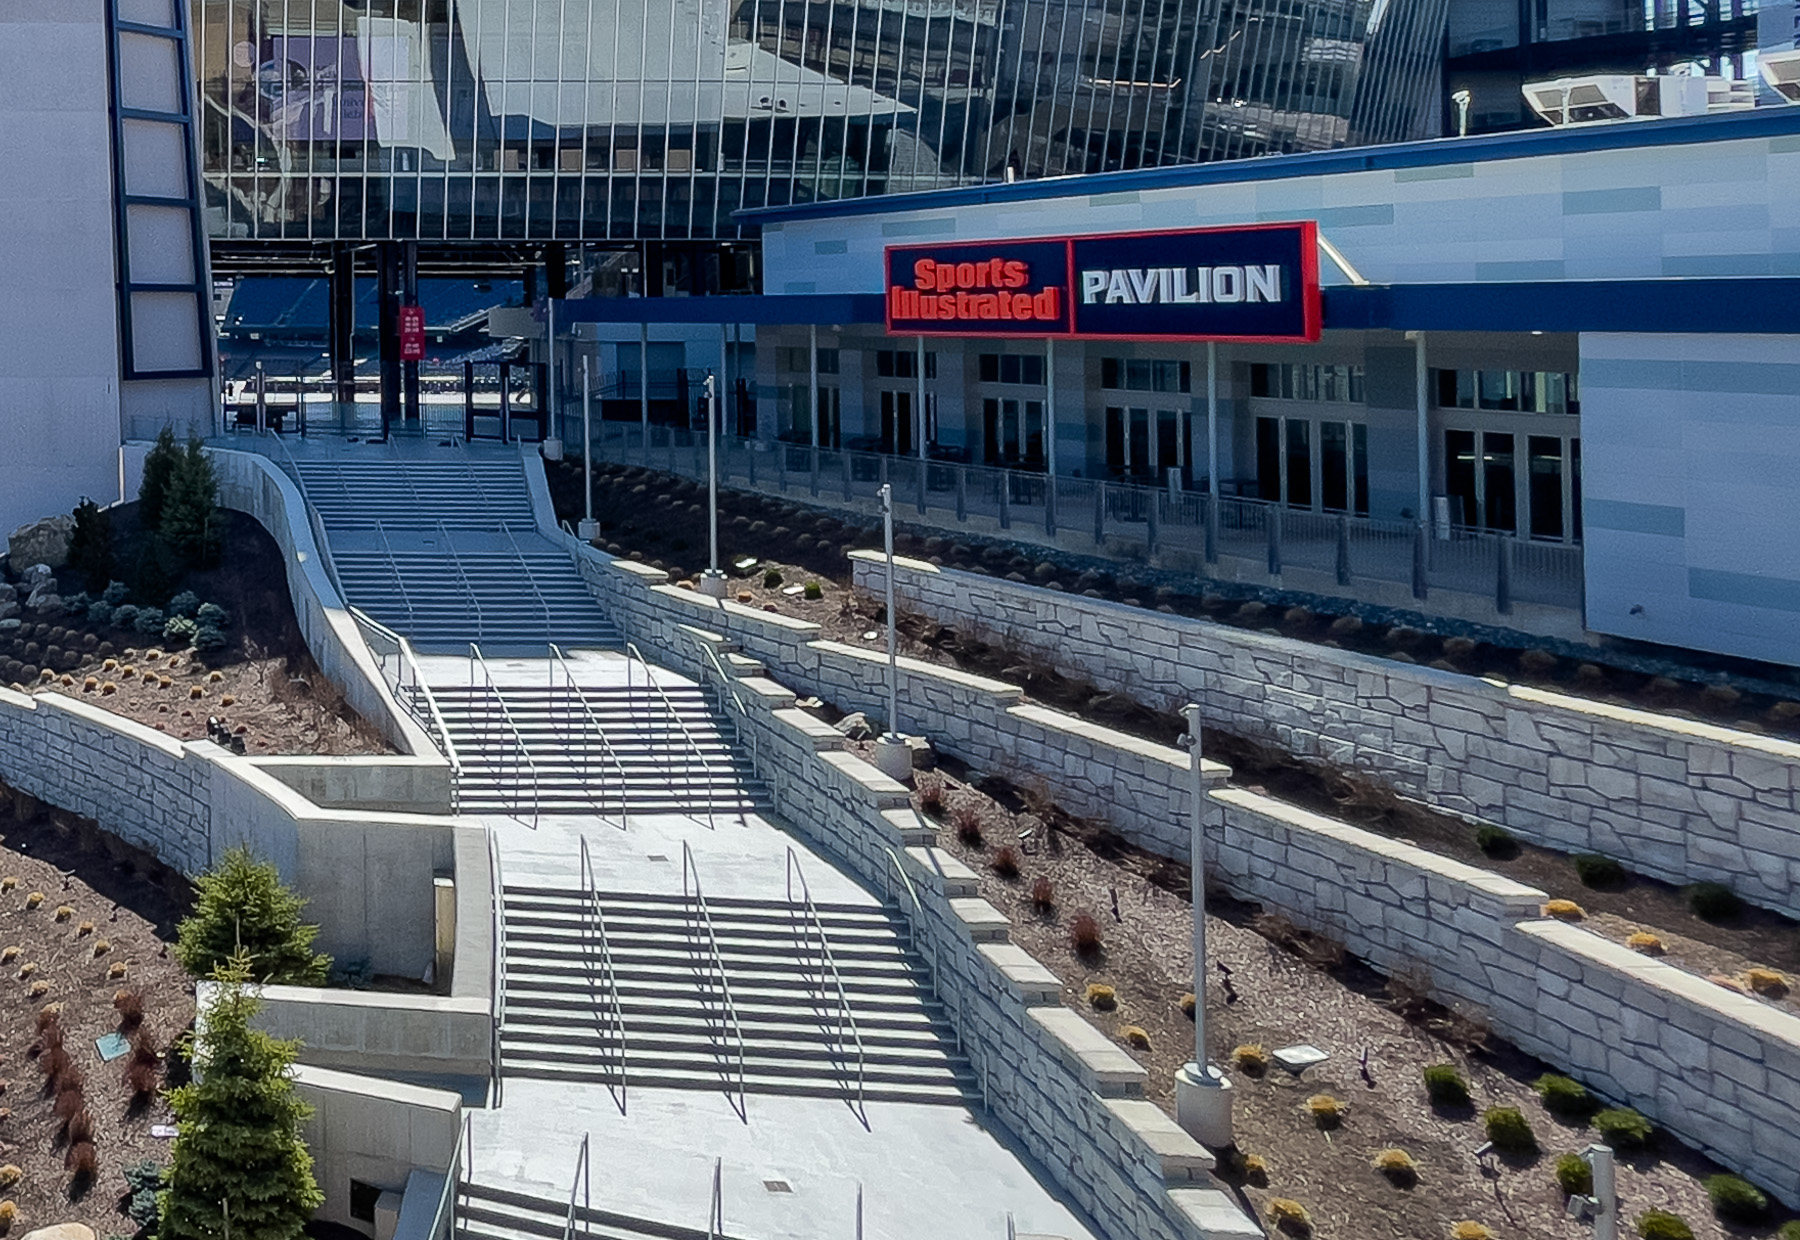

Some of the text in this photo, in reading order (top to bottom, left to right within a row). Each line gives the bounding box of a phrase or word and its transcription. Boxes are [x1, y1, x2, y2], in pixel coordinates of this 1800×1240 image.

[913, 257, 1029, 293] Sports
[1081, 263, 1282, 306] PAVILION
[891, 285, 1061, 321] Illustrated
